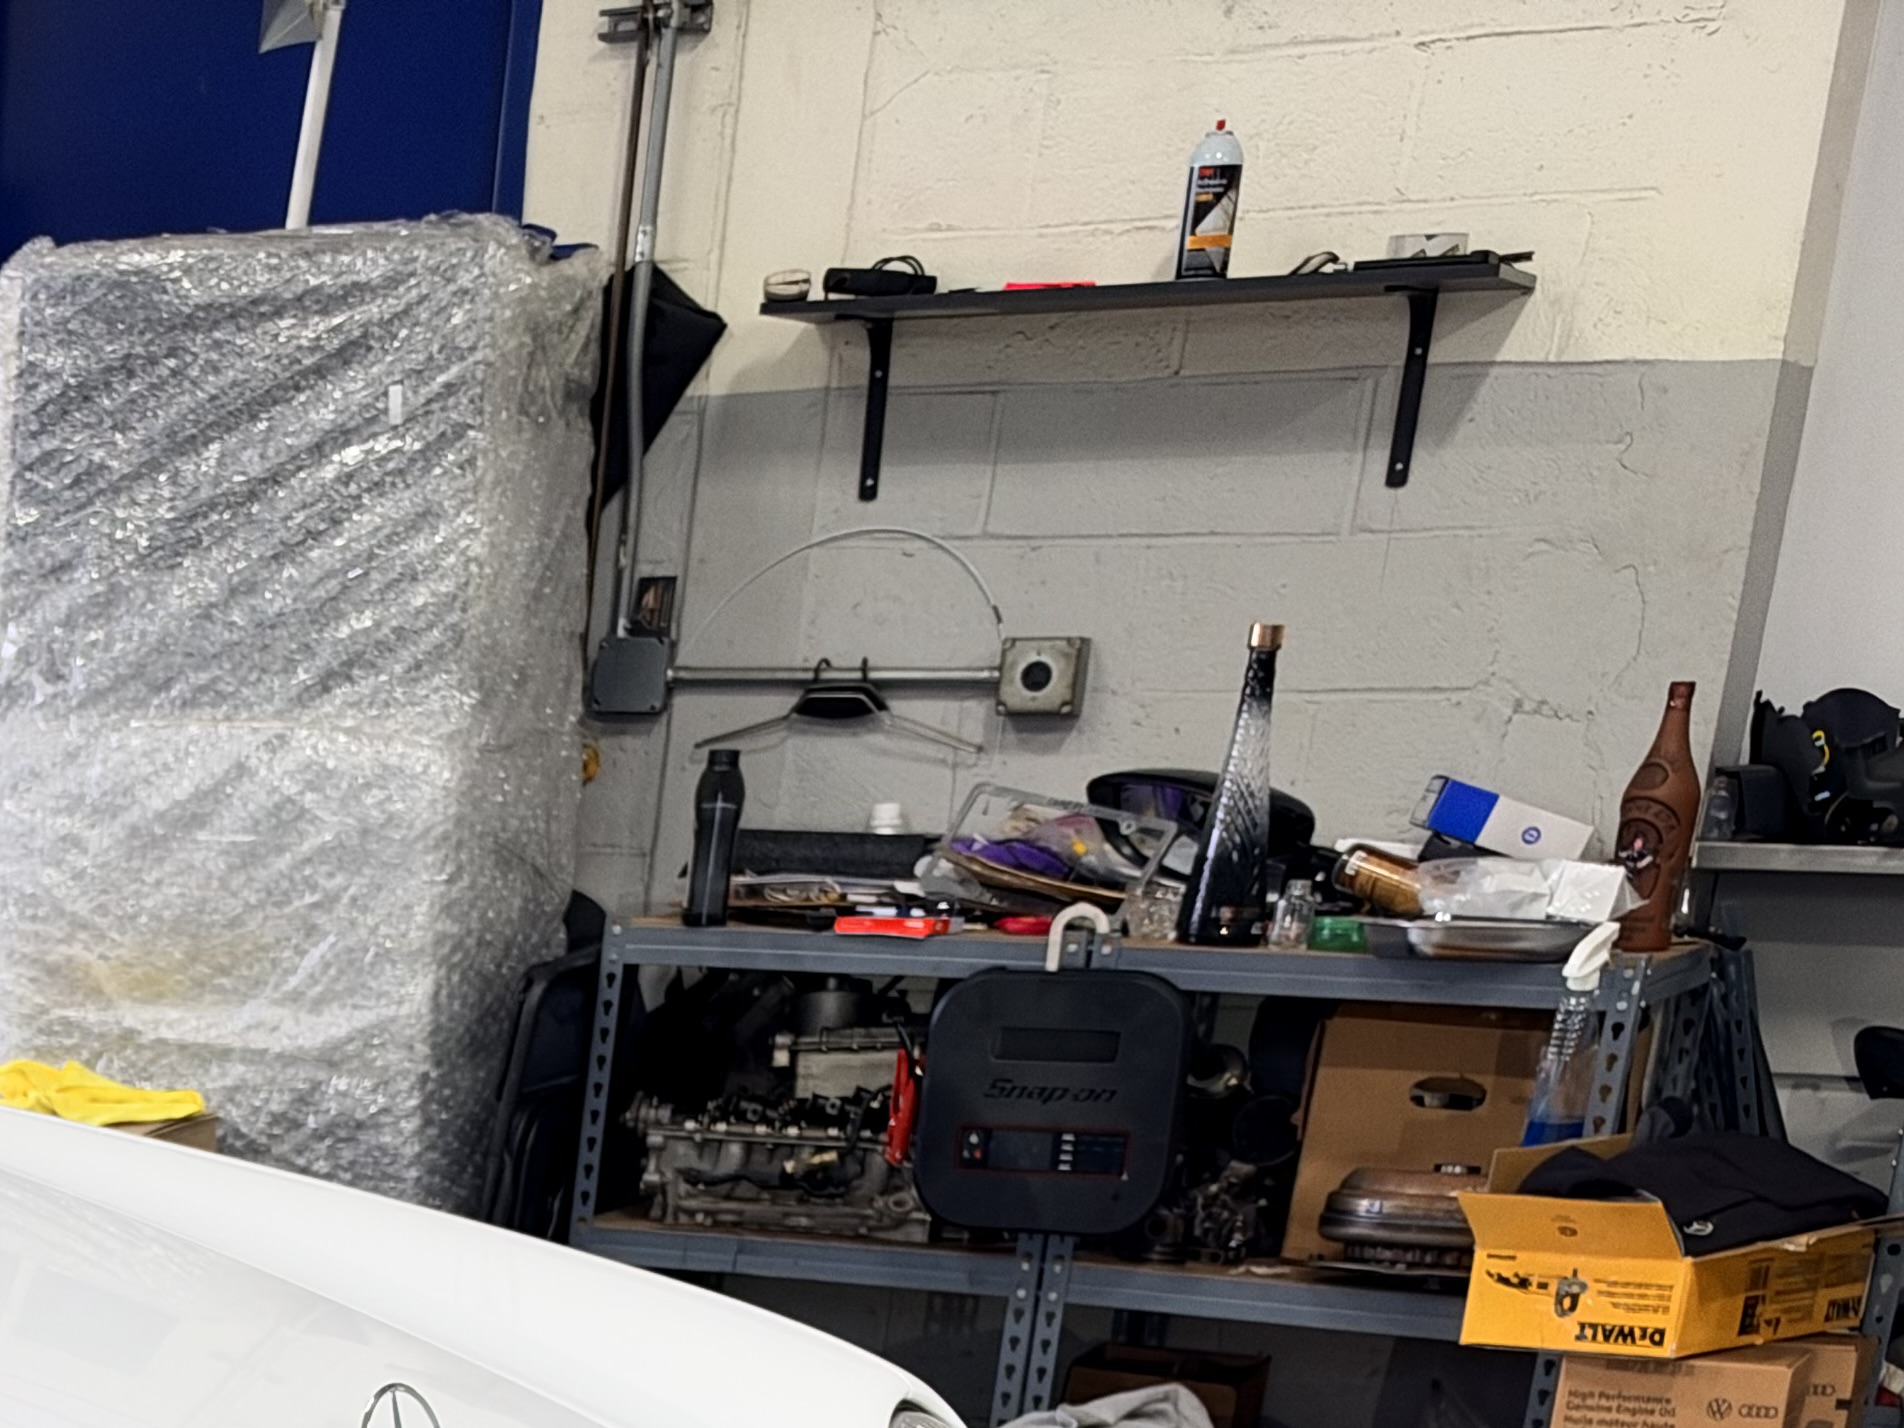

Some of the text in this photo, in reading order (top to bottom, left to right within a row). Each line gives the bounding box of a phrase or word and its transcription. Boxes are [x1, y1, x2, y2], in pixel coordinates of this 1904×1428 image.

[983, 1077, 1118, 1105] Snap-on
[1598, 1390, 1672, 1405] Performance
[1616, 1404, 1656, 1417] Engine
